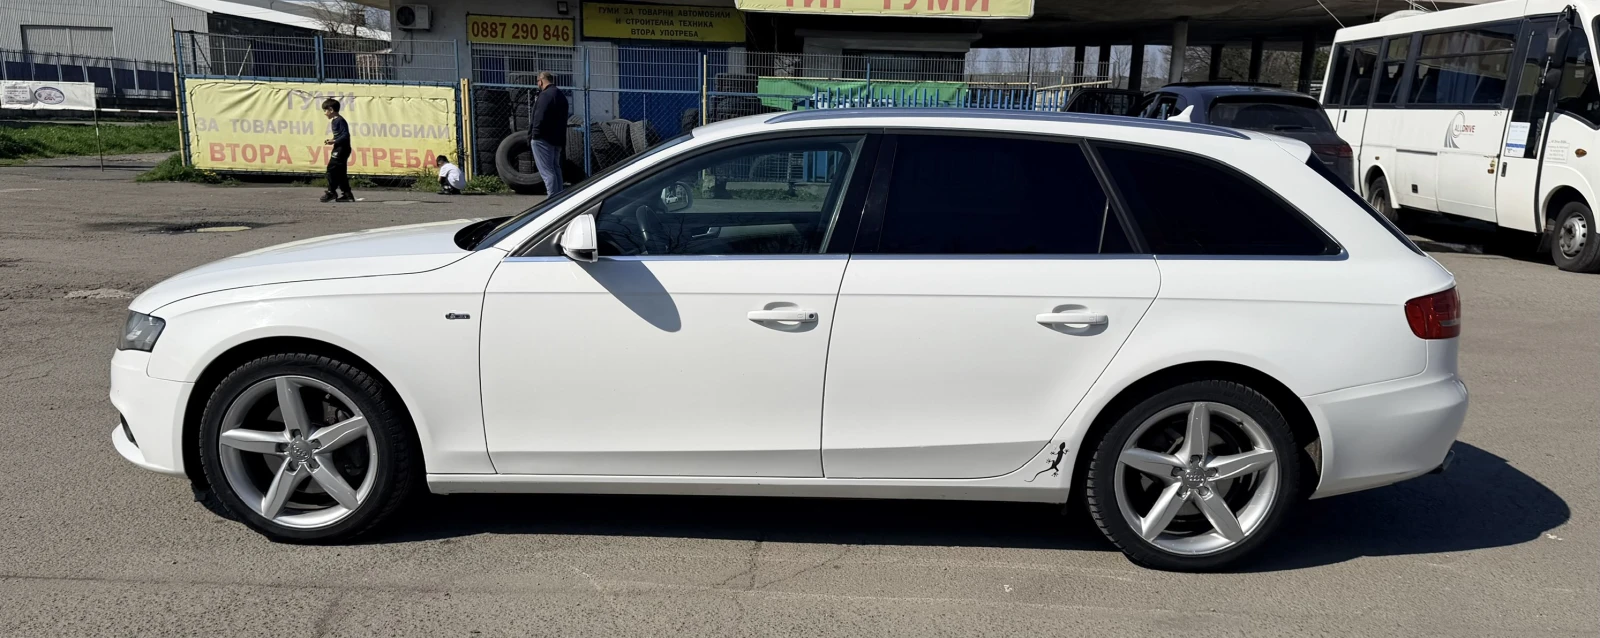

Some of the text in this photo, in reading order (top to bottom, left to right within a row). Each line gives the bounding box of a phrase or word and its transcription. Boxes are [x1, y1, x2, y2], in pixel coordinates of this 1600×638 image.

[597, 6, 731, 19] ГУМИ ЗА ТОВАРНИ АВТОМОБИЛИ
[615, 17, 714, 28] И СТРОИТЕЛНА ТЕХНИКА
[471, 21, 570, 42] 0887 290 846
[631, 28, 699, 38] ВТОРА УПОТРЕБА
[196, 116, 450, 140] ЗА ТОВАРНИ АТОМОБИЛИ
[209, 142, 293, 165] ВТОРА
